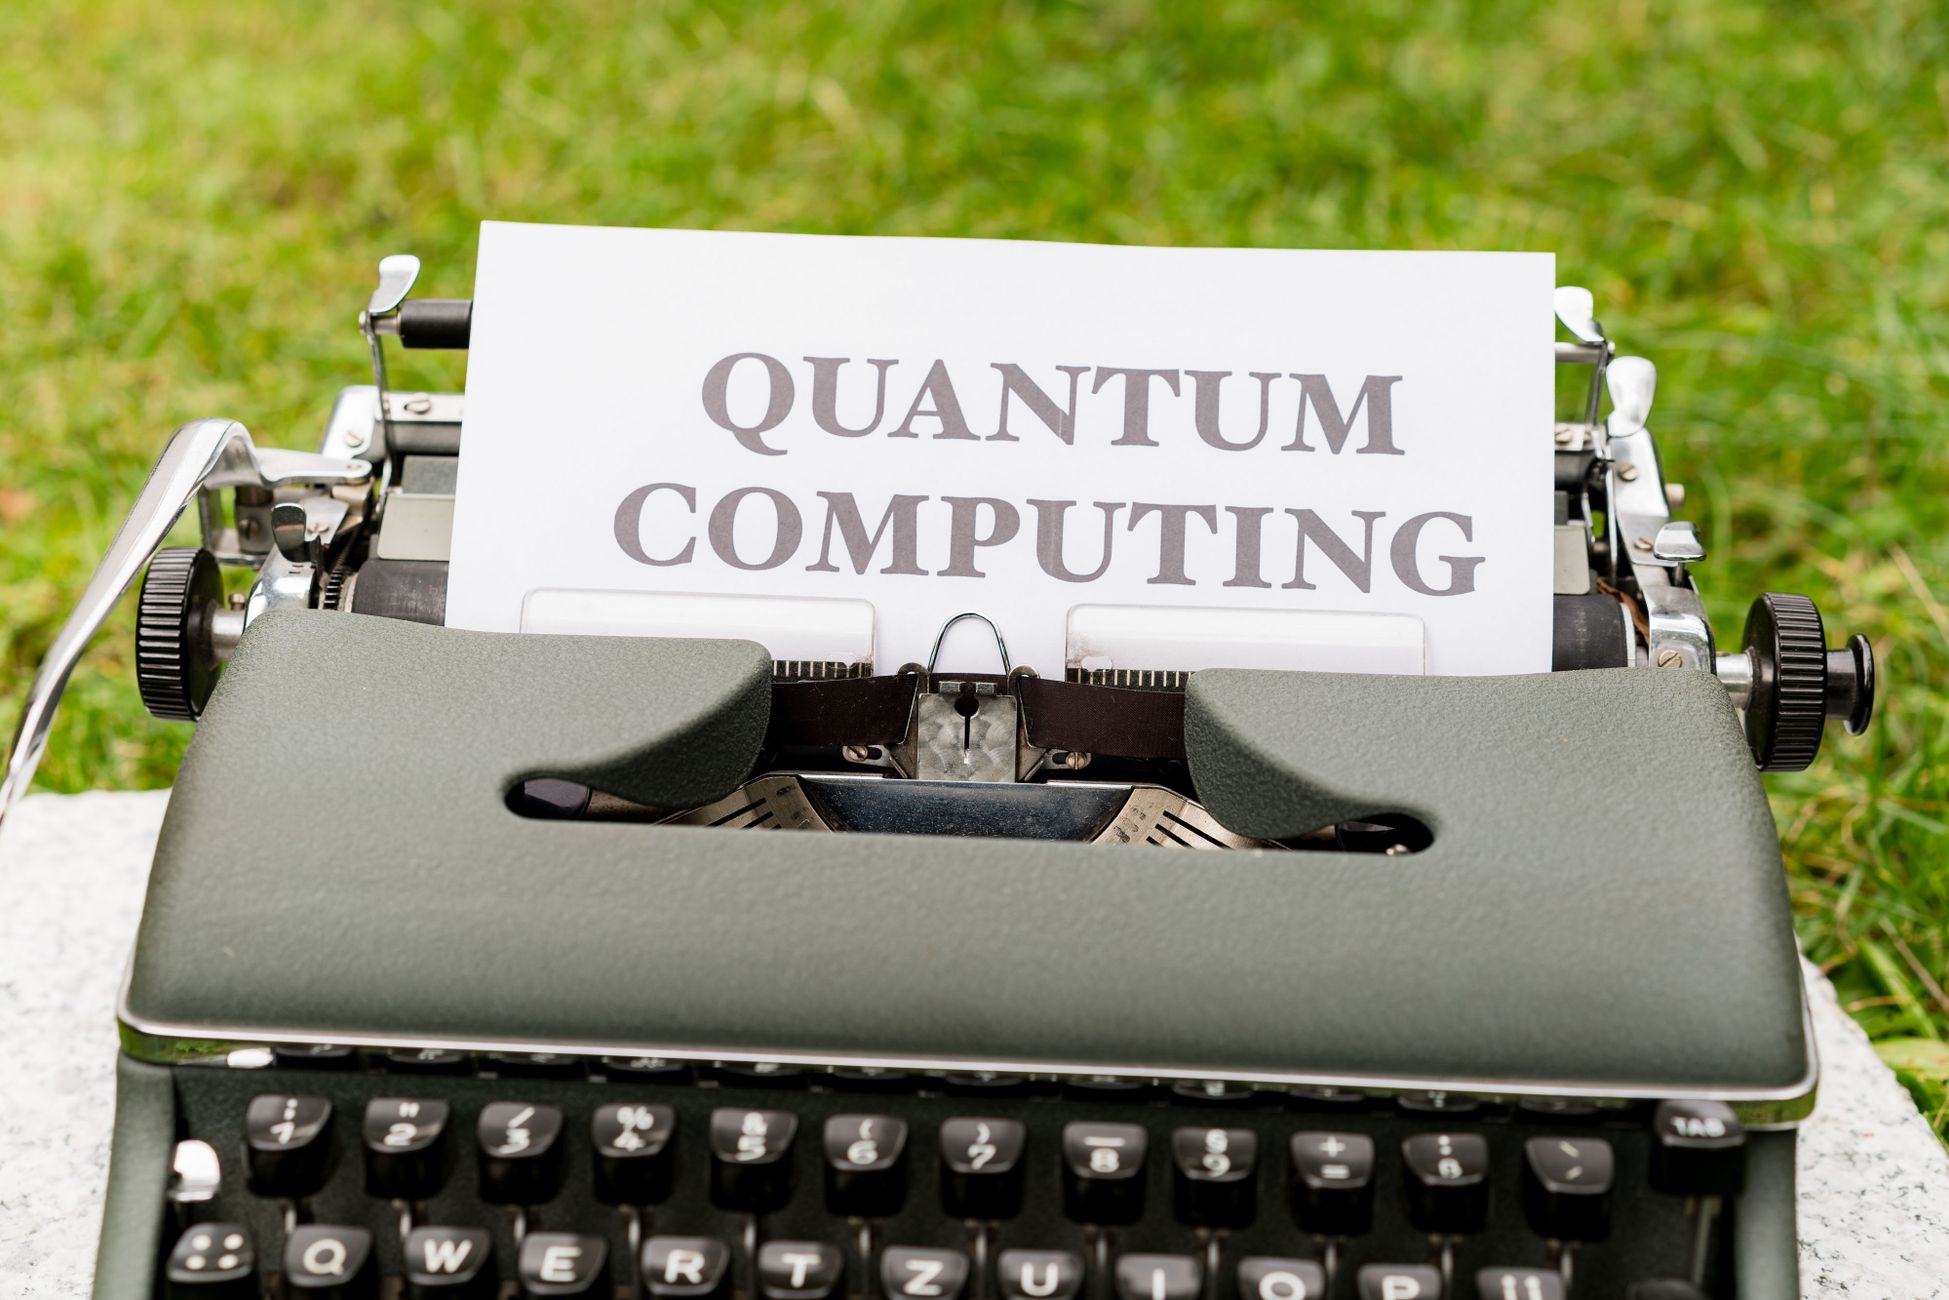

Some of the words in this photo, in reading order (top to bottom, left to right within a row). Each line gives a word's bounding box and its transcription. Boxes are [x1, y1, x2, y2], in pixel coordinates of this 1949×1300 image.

[701, 352, 1406, 457] QUANTUM
[613, 482, 1487, 597] COMPUTING
[383, 1122, 417, 1146] 2
[499, 1128, 530, 1154] 3
[1670, 1116, 1726, 1137] TAB
[735, 1135, 767, 1161] 5
[847, 1140, 878, 1165] 6
[968, 1143, 997, 1170] 7
[1090, 1148, 1120, 1173] 8
[1203, 1153, 1231, 1177] 9
[303, 1238, 346, 1275] Q
[423, 1238, 472, 1273] W
[538, 1245, 581, 1282] E
[664, 1248, 706, 1284] R
[780, 1252, 820, 1287] T
[904, 1259, 944, 1296] Z
[1020, 1261, 1060, 1297] U
[1151, 1267, 1166, 1300] I
[1258, 1271, 1306, 1300] O
[1382, 1275, 1421, 1300] P
